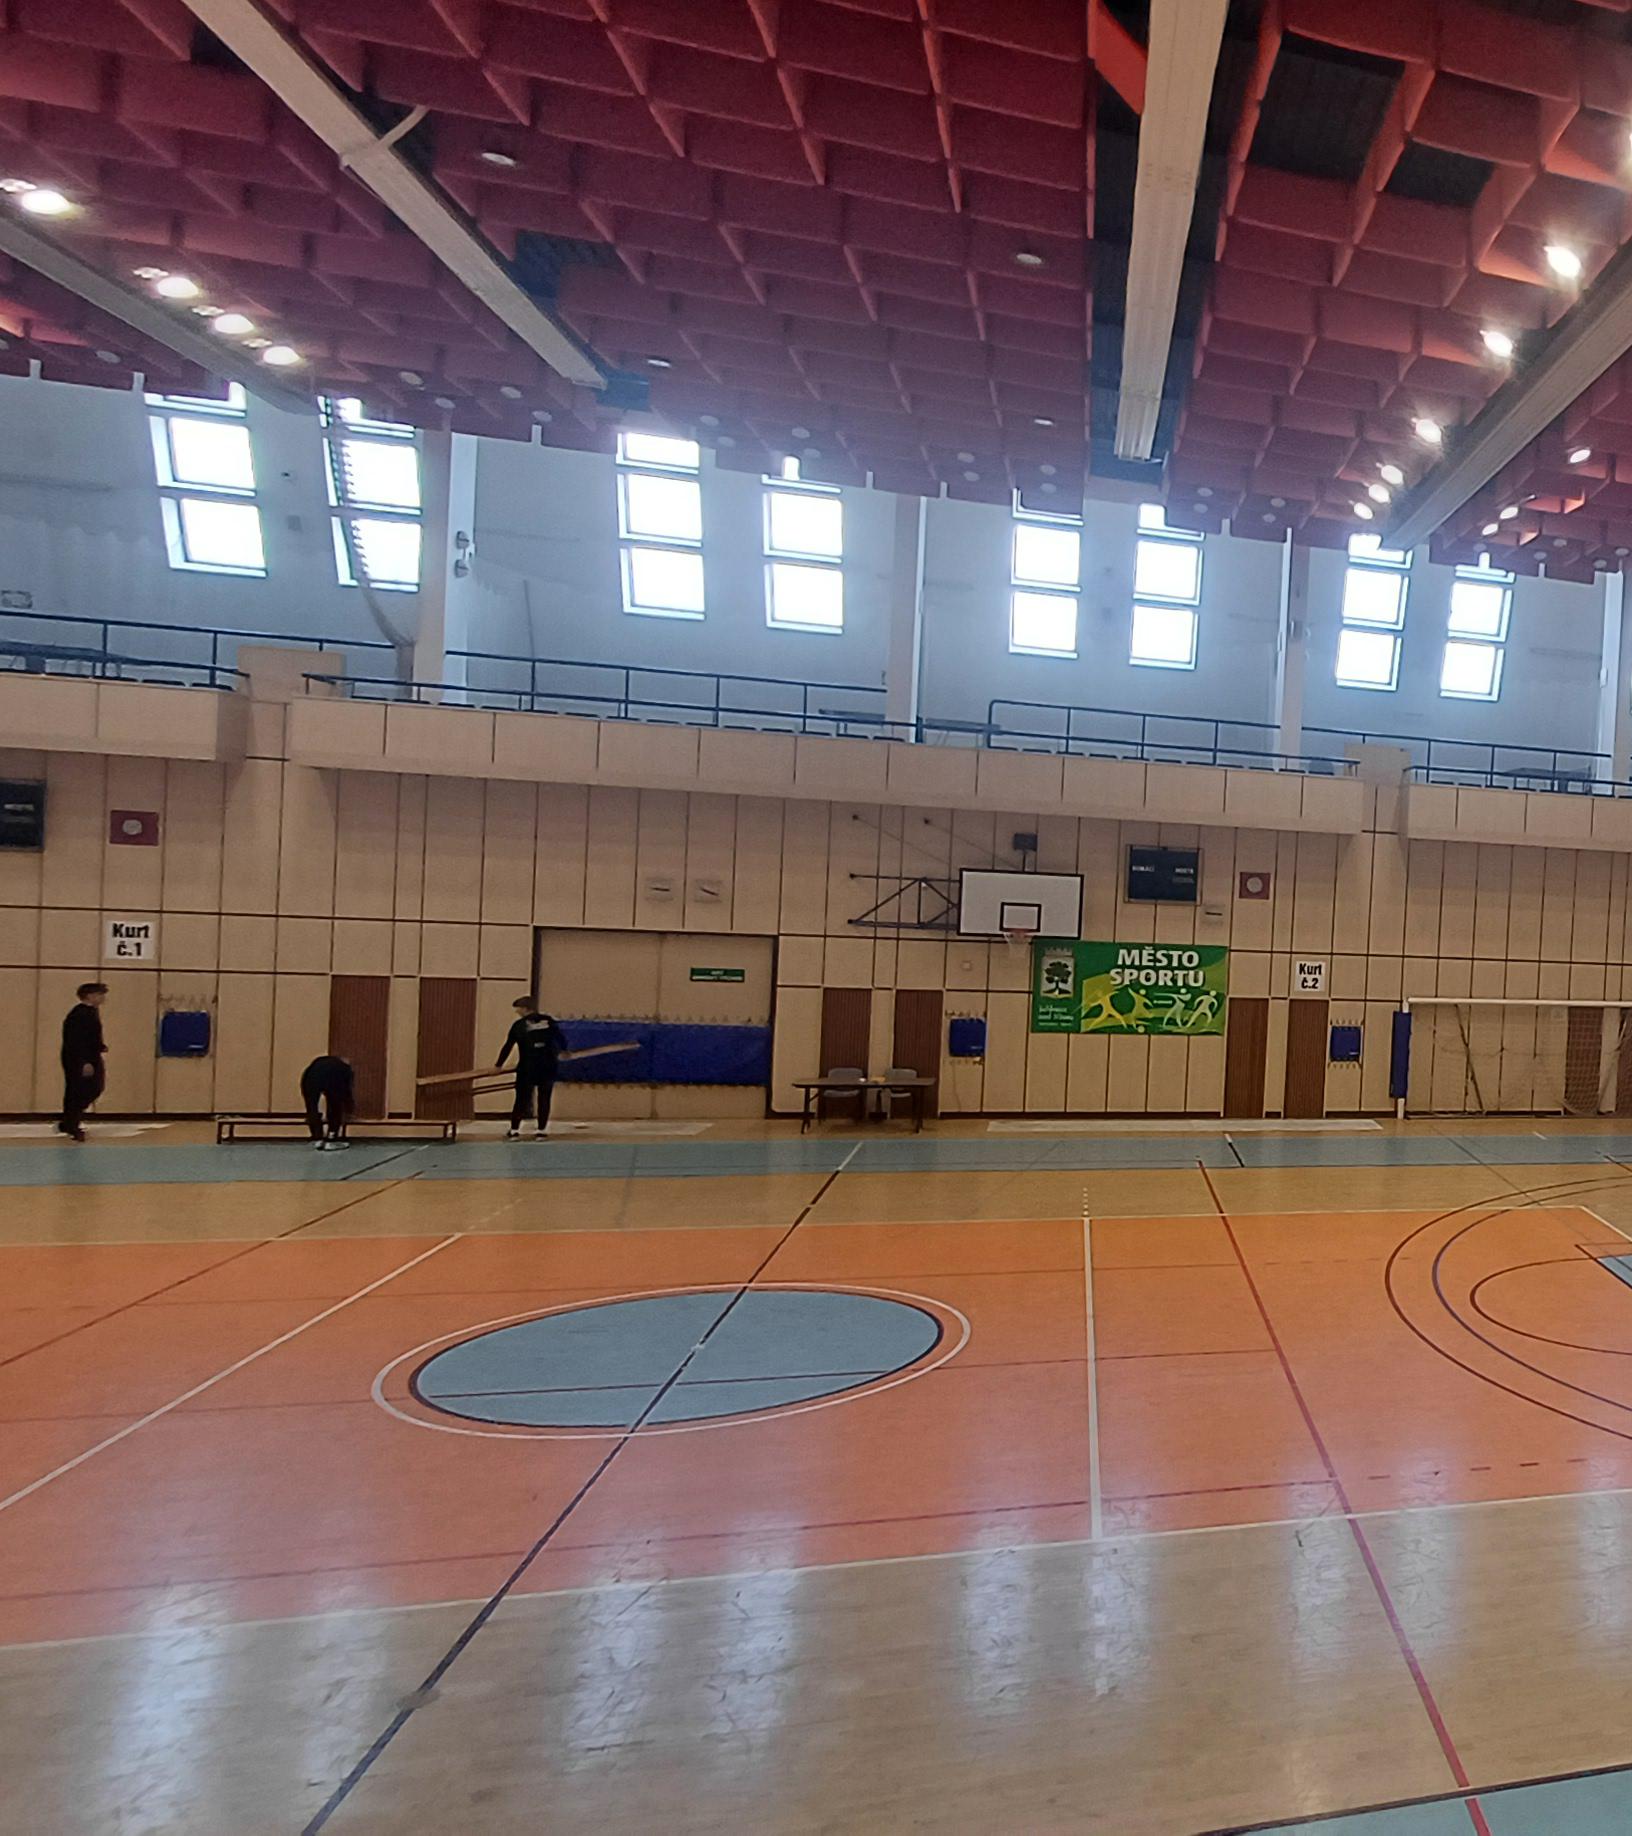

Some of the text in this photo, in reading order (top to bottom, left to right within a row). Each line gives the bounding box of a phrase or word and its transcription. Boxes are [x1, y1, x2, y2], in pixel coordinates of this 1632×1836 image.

[112, 923, 149, 938] Kurt
[117, 941, 142, 956] č.1
[1117, 946, 1199, 967] MĚSTO
[1299, 963, 1322, 975] Kurt
[1109, 968, 1204, 986] SPORTU
